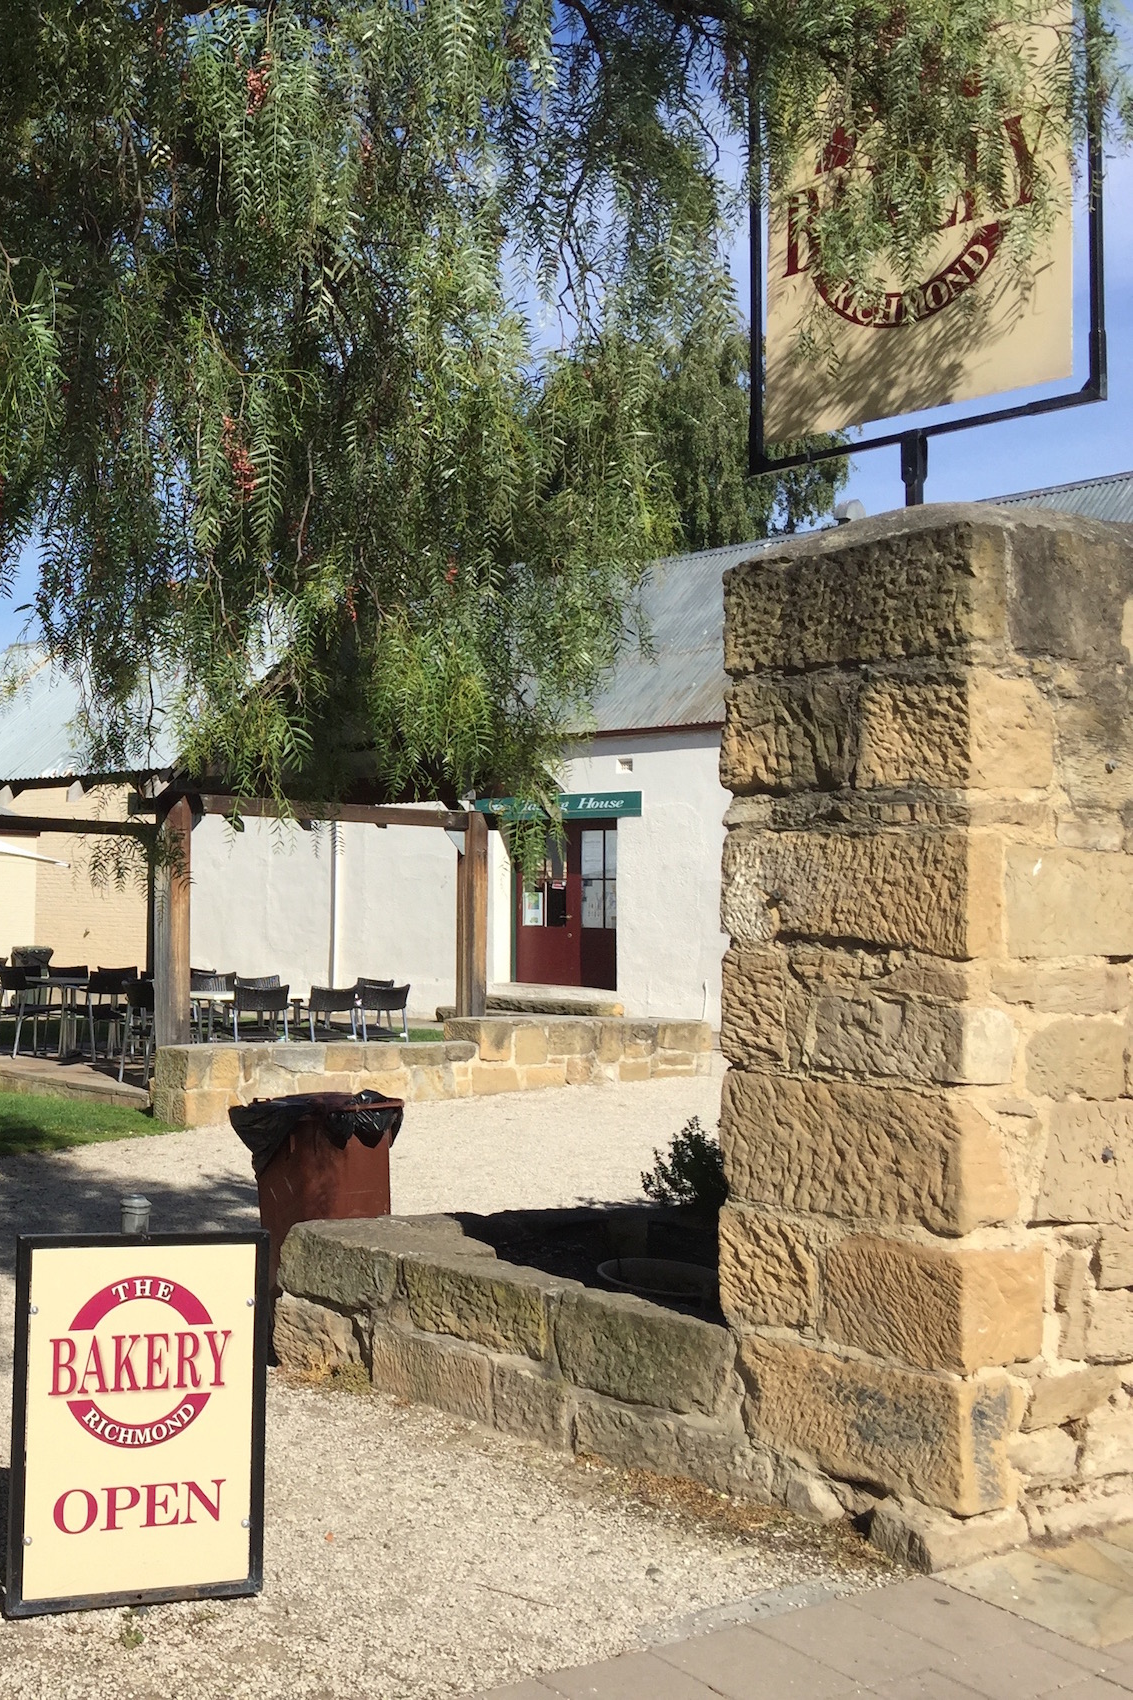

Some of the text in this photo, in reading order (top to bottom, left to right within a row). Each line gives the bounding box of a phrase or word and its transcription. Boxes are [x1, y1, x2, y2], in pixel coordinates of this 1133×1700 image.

[577, 797, 624, 810] House
[111, 1278, 176, 1303] THE
[47, 1329, 232, 1397] BAKERY
[80, 1402, 196, 1445] RICHMOND
[52, 1478, 227, 1535] OPEN
